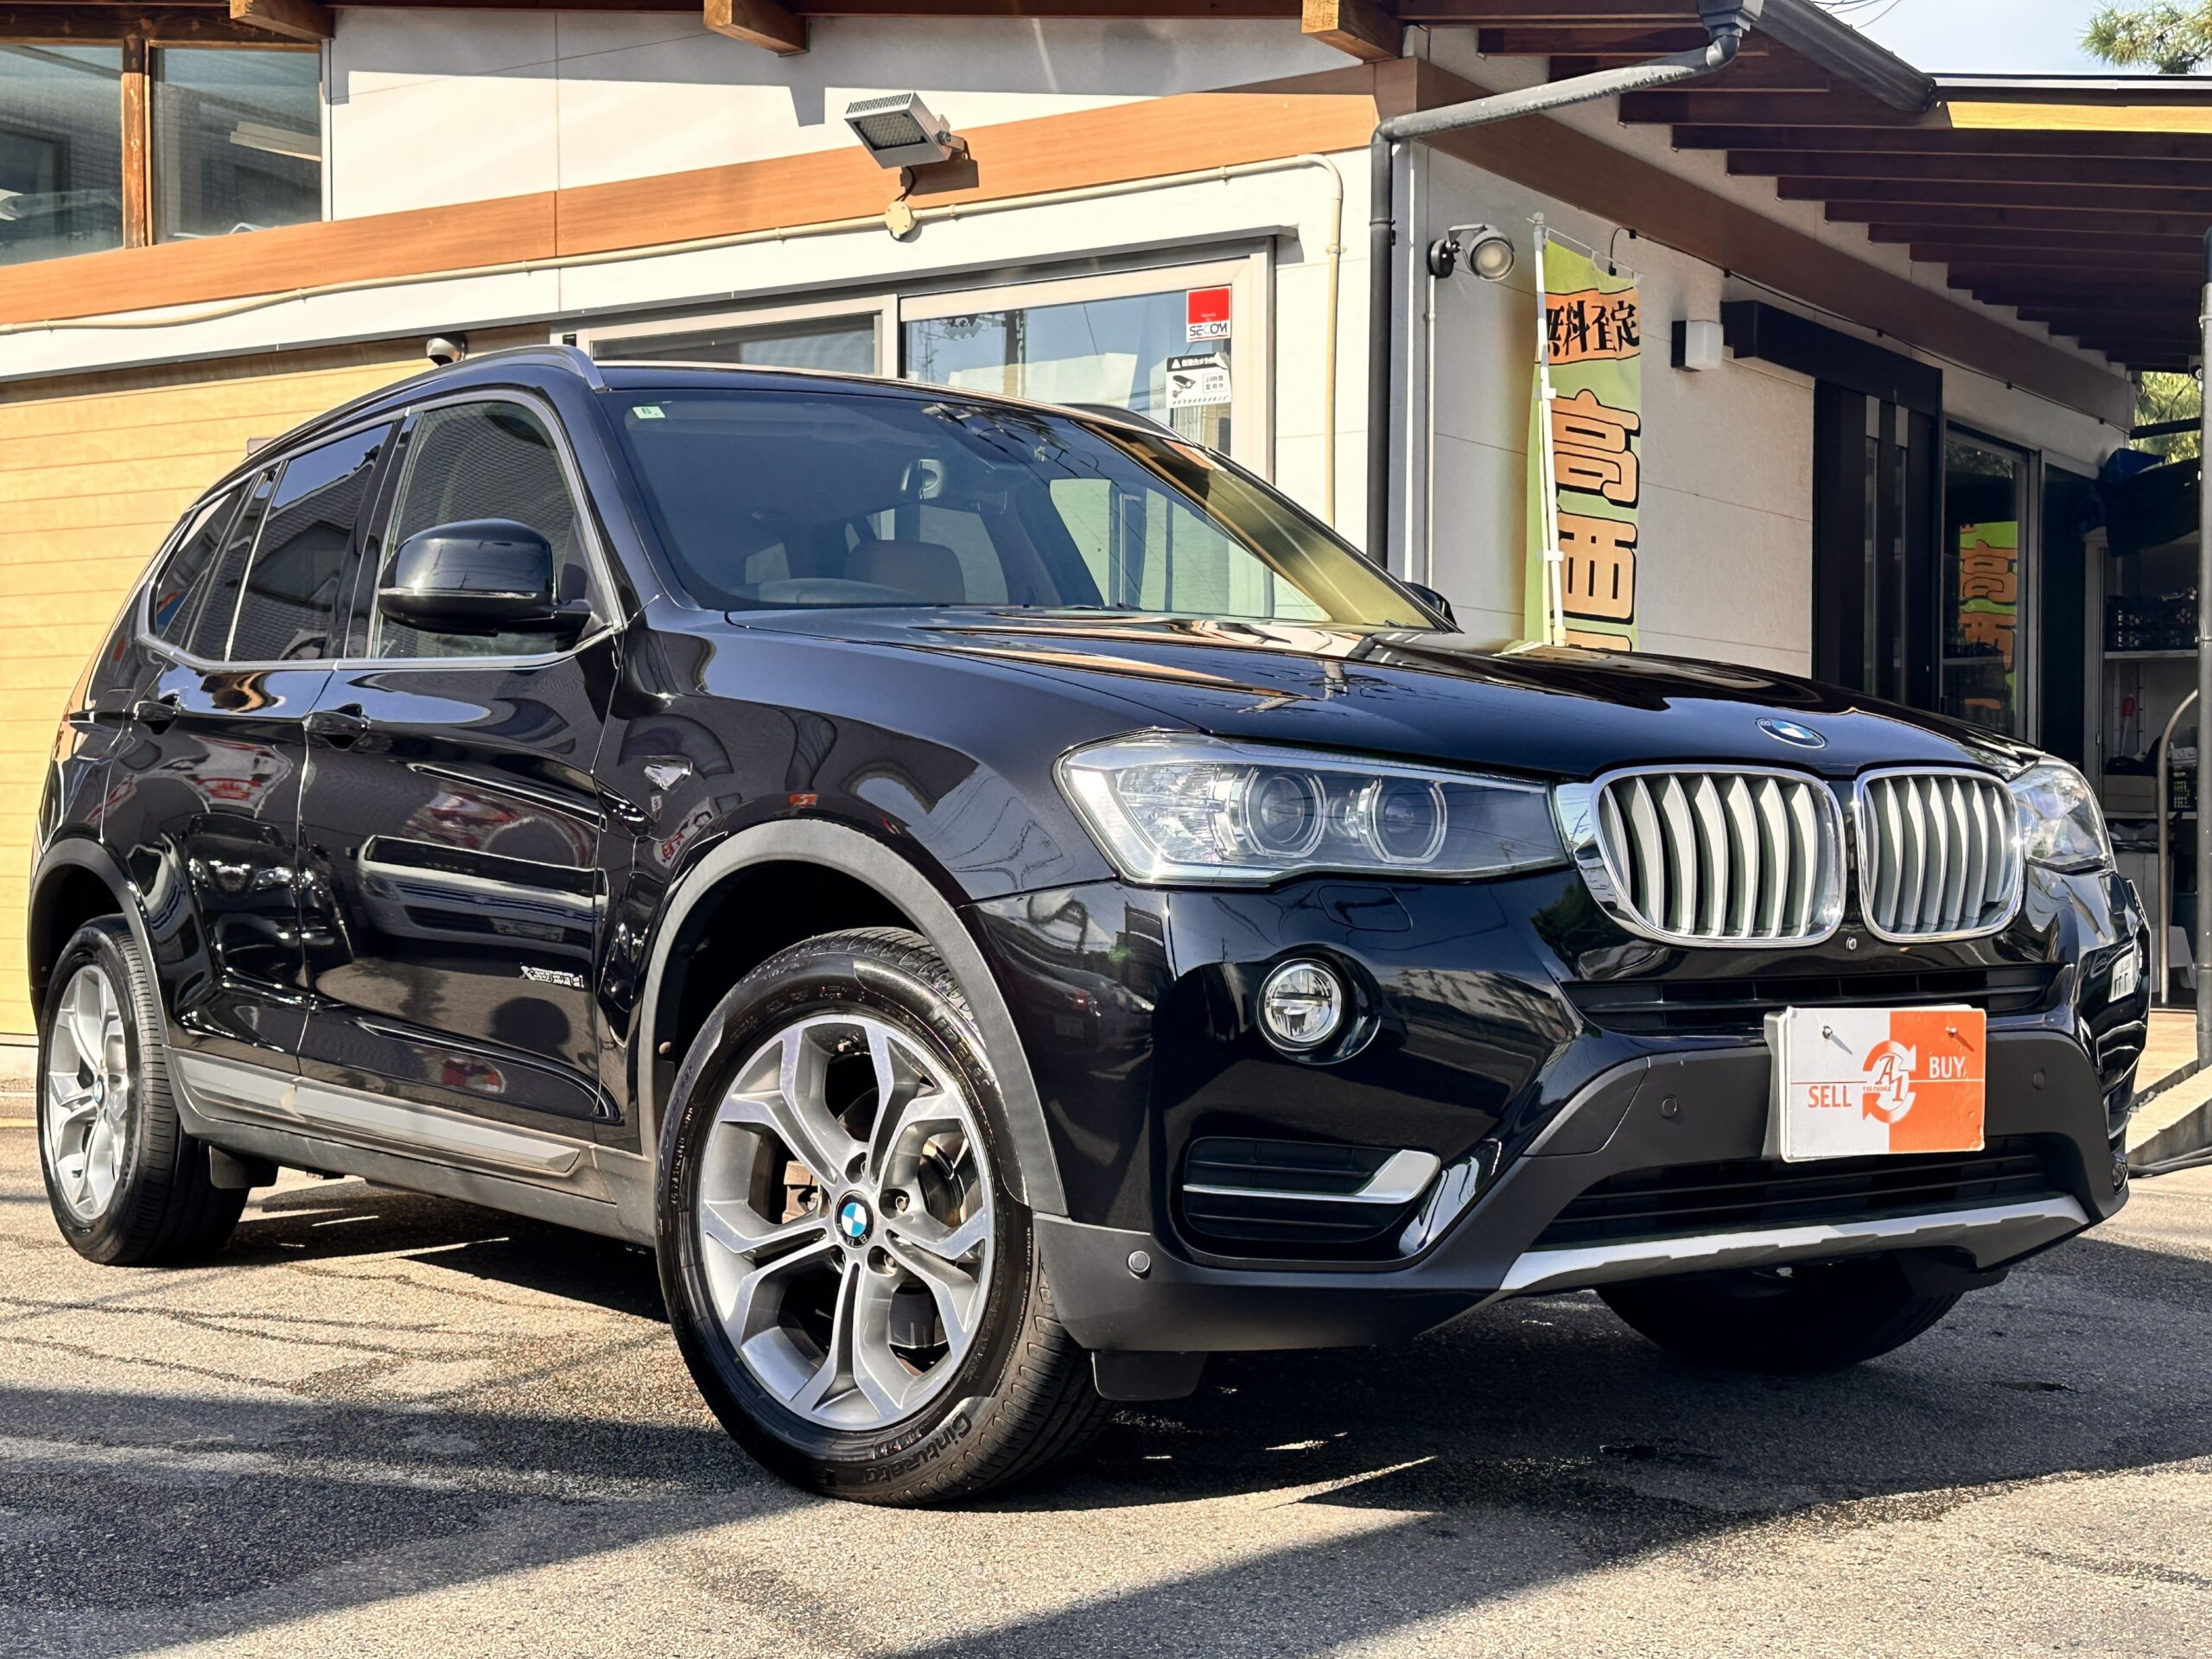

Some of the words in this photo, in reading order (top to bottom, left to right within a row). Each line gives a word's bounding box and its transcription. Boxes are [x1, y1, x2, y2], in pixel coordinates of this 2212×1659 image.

[1189, 322, 1228, 336] SECOM
[1929, 1055, 1966, 1079] BUY
[1808, 1084, 1853, 1109] SELL
